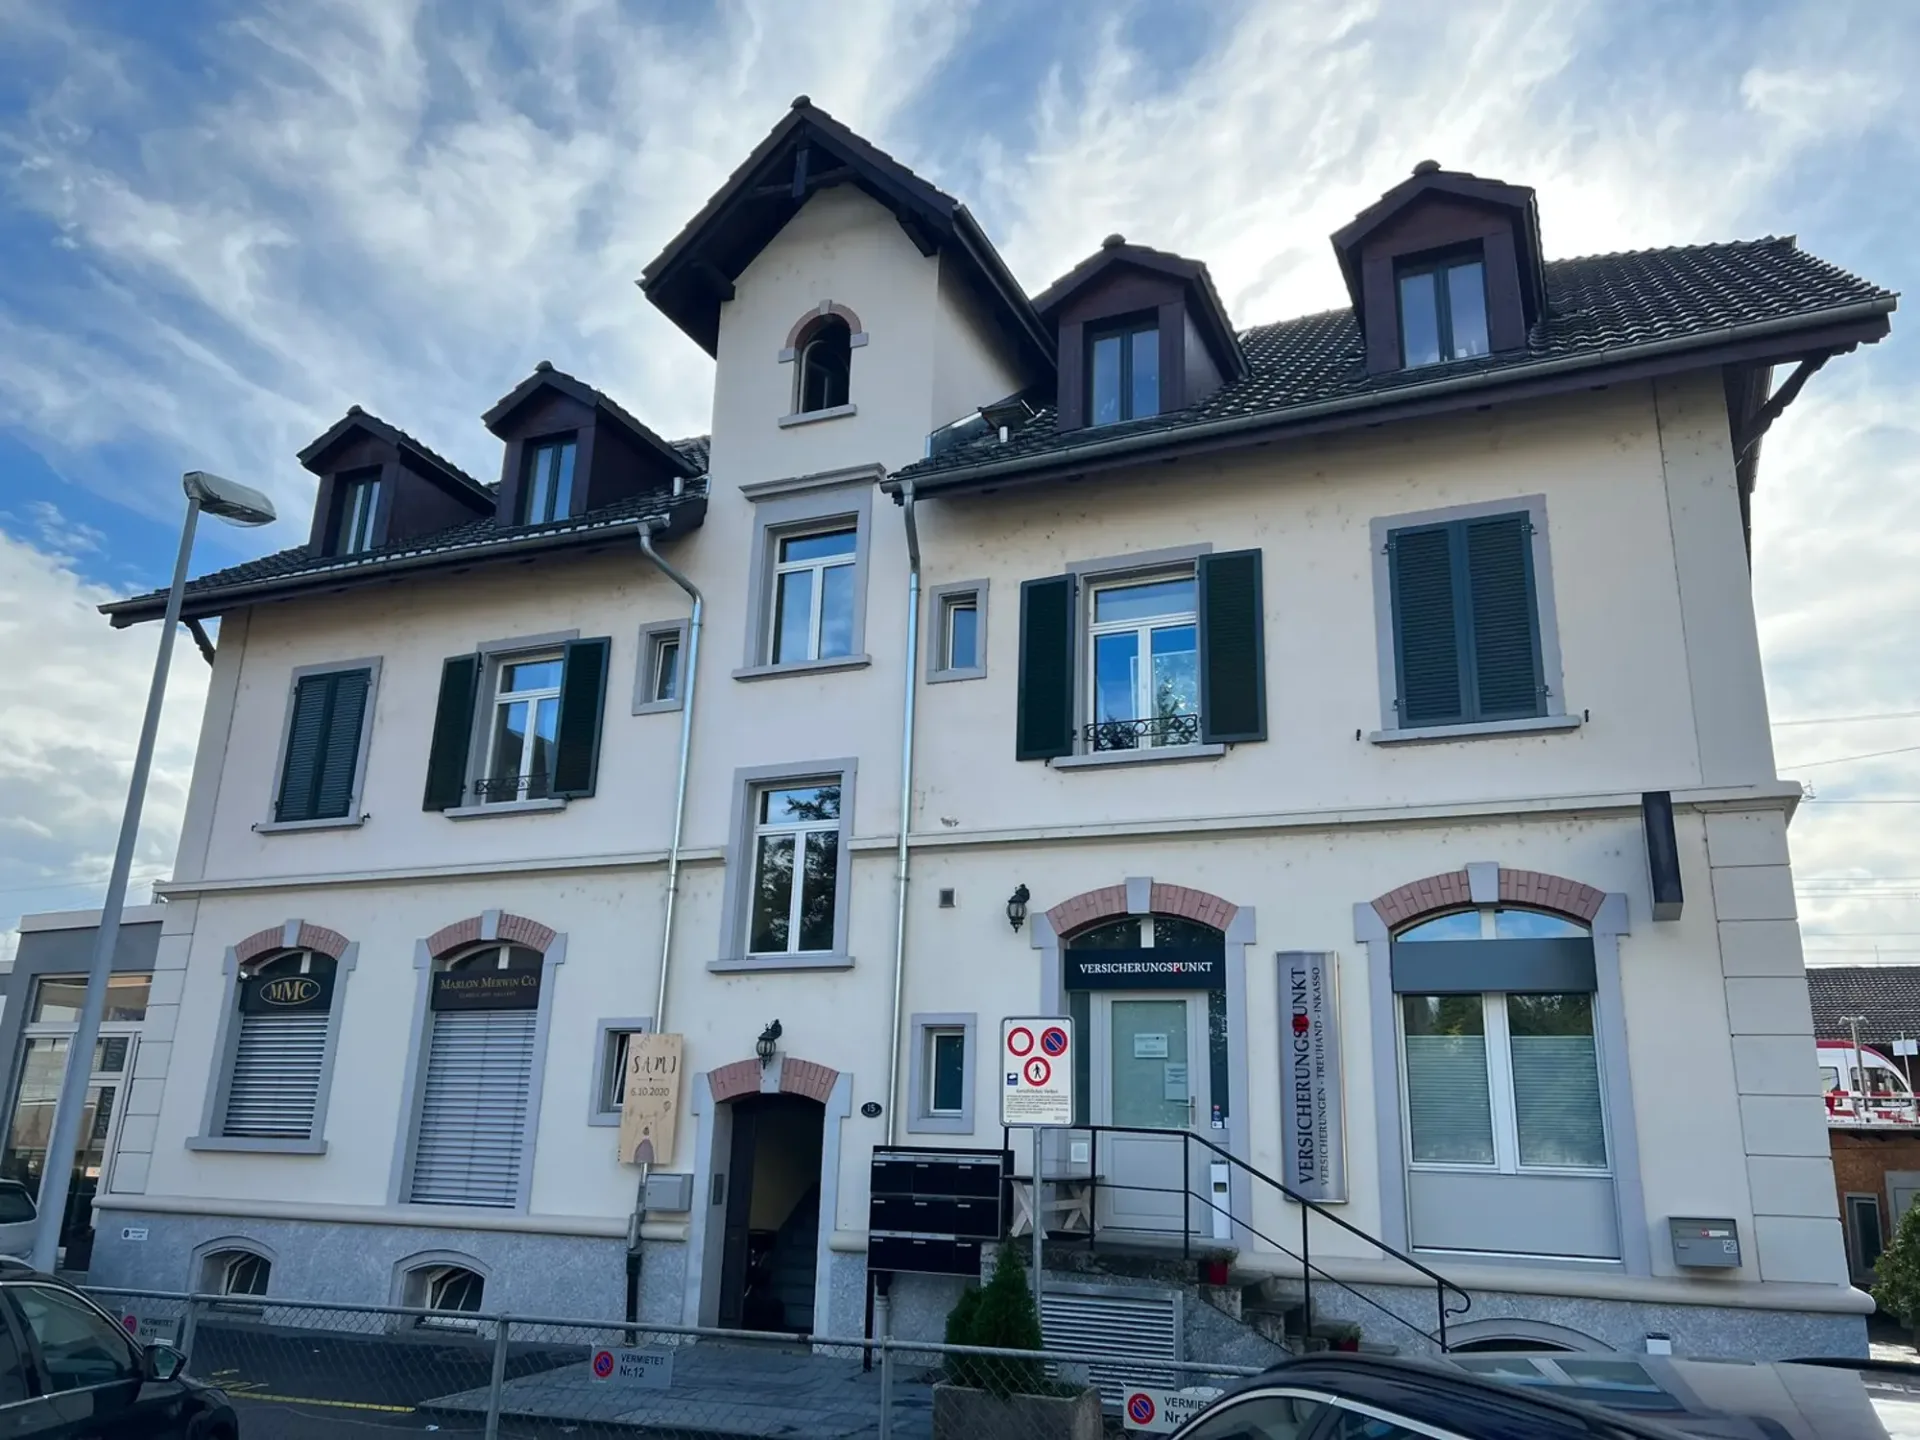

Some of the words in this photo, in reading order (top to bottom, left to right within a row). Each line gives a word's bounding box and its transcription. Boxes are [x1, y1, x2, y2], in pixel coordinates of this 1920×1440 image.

[1079, 962, 1213, 974] VERSICHERUNGSPUNKT
[269, 980, 312, 1001] MMC
[1312, 967, 1321, 1012] INKASSO
[1314, 1021, 1325, 1079] TREUHAND
[1291, 967, 1315, 1185] VERSICHERUNGSPUNKT
[630, 1087, 670, 1097] 6.10.2020
[1317, 1087, 1329, 1186] VERSICHERUNGEN
[621, 1353, 664, 1365] VERMIETET
[619, 1365, 645, 1378] Nr.12
[1164, 1396, 1209, 1410] VERMIE
